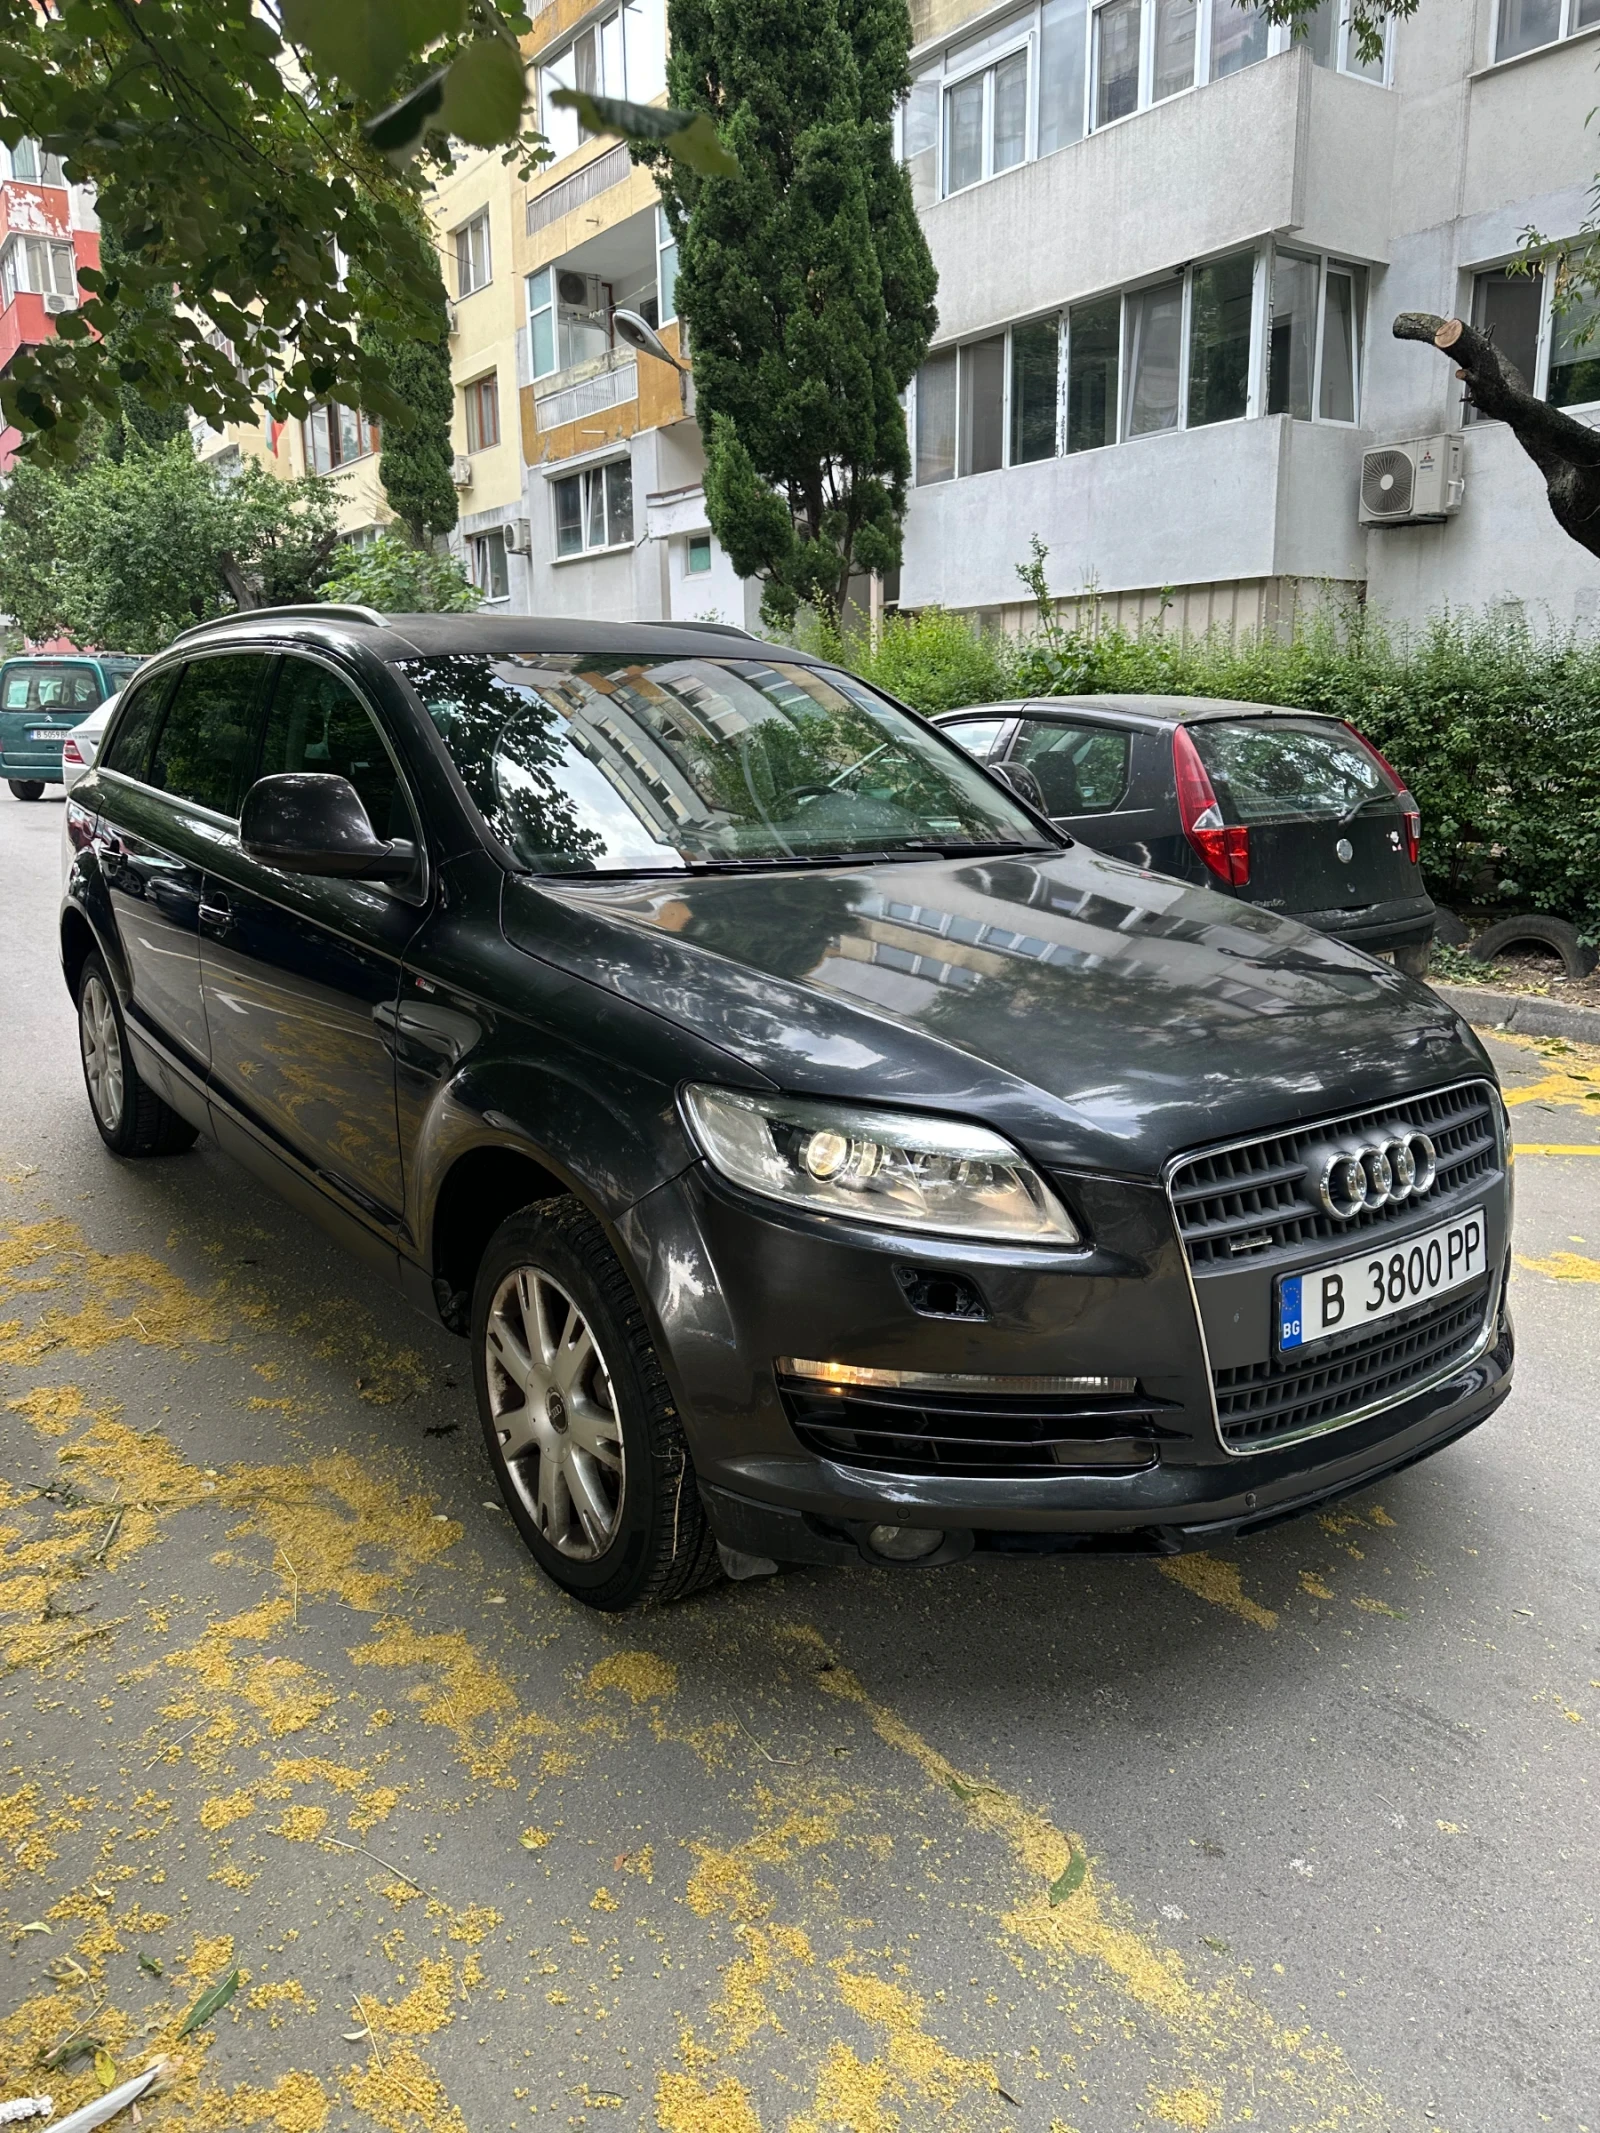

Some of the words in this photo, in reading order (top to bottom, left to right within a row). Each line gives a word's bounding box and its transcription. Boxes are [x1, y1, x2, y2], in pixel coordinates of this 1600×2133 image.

[1322, 1273, 1345, 1328] B
[1366, 1239, 1442, 1312] 3800
[1447, 1221, 1480, 1280] PP
[1283, 1320, 1300, 1339] BG
